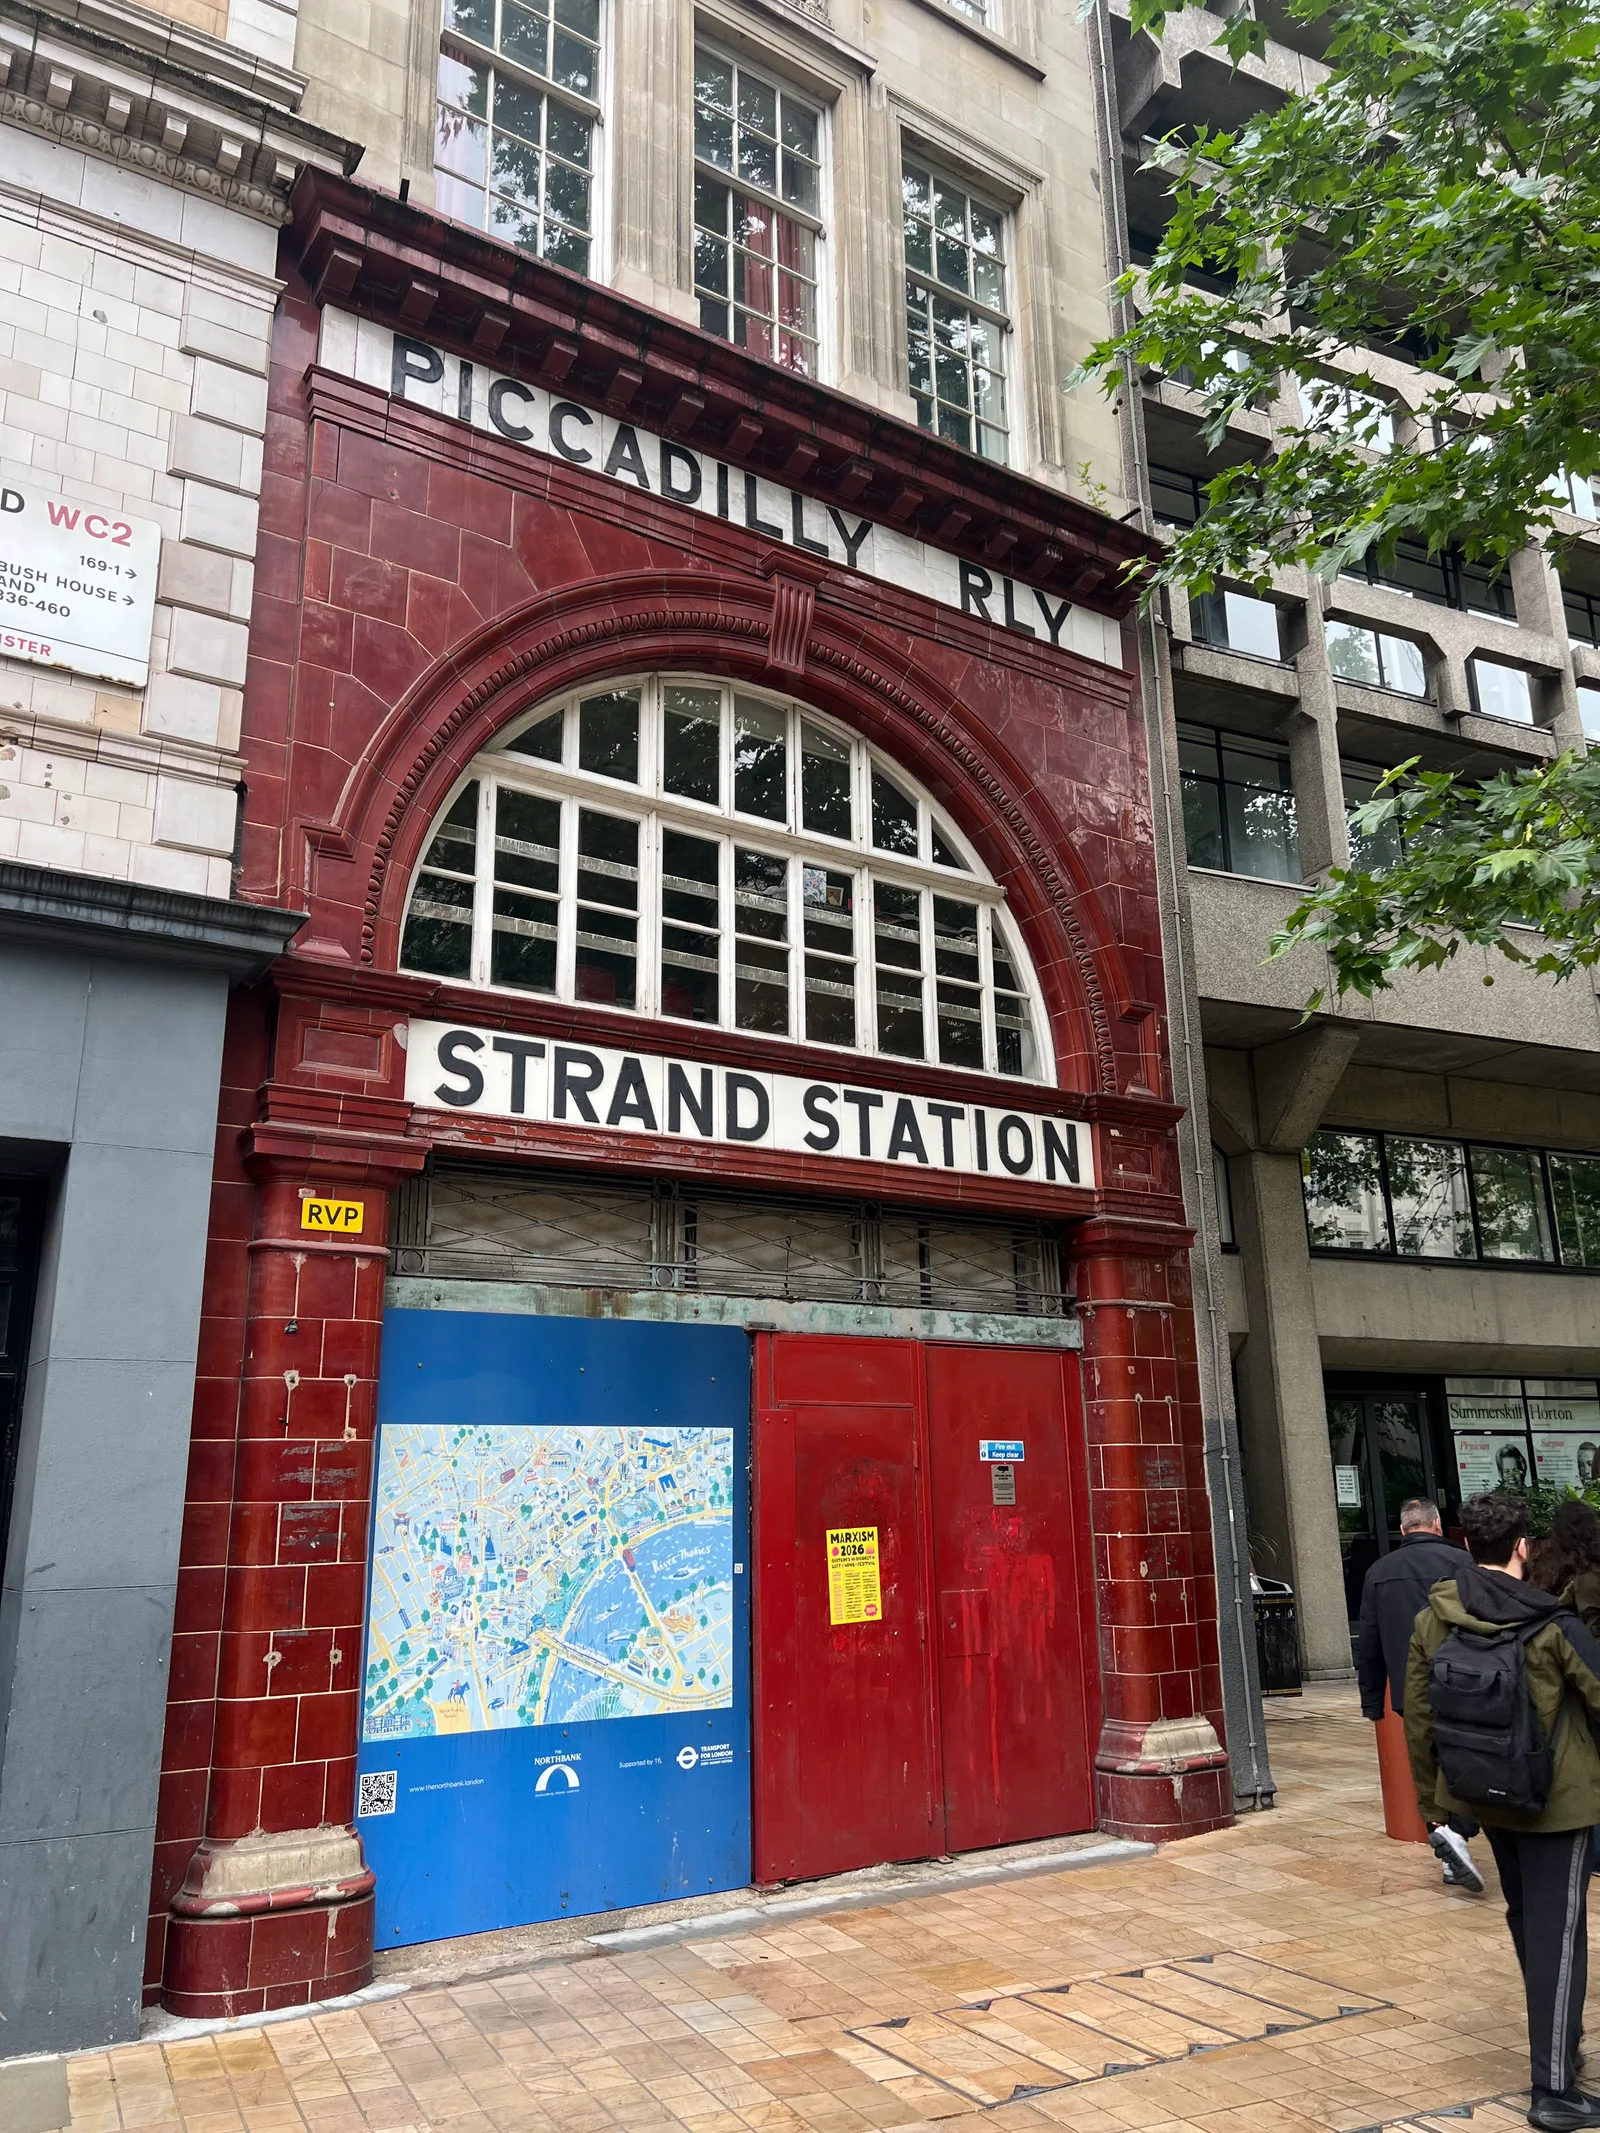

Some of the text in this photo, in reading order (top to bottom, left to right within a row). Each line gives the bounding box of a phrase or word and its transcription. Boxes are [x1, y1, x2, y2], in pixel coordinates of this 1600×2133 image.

[392, 334, 1072, 644] PICCADILLY RLY
[47, 501, 133, 547] WC2
[79, 555, 120, 575] 169-1
[0, 561, 117, 602] BUSH HOUSE
[0, 633, 51, 656] STER
[434, 1031, 1080, 1183] STRAND STATION
[308, 1204, 359, 1226] RVP
[1450, 1402, 1573, 1420] Summerskill Horton
[992, 1451, 1005, 1459] Keep
[830, 1531, 875, 1544] MARXISM
[652, 1545, 711, 1573] River Thames
[841, 1544, 864, 1556] 2026
[701, 1744, 730, 1752] TRANSPORT
[711, 1750, 733, 1758] LONDON
[534, 1753, 582, 1765] NORTHBANK
[619, 1760, 645, 1768] Supported
[409, 1778, 485, 1793] www.thenorthbank.london
